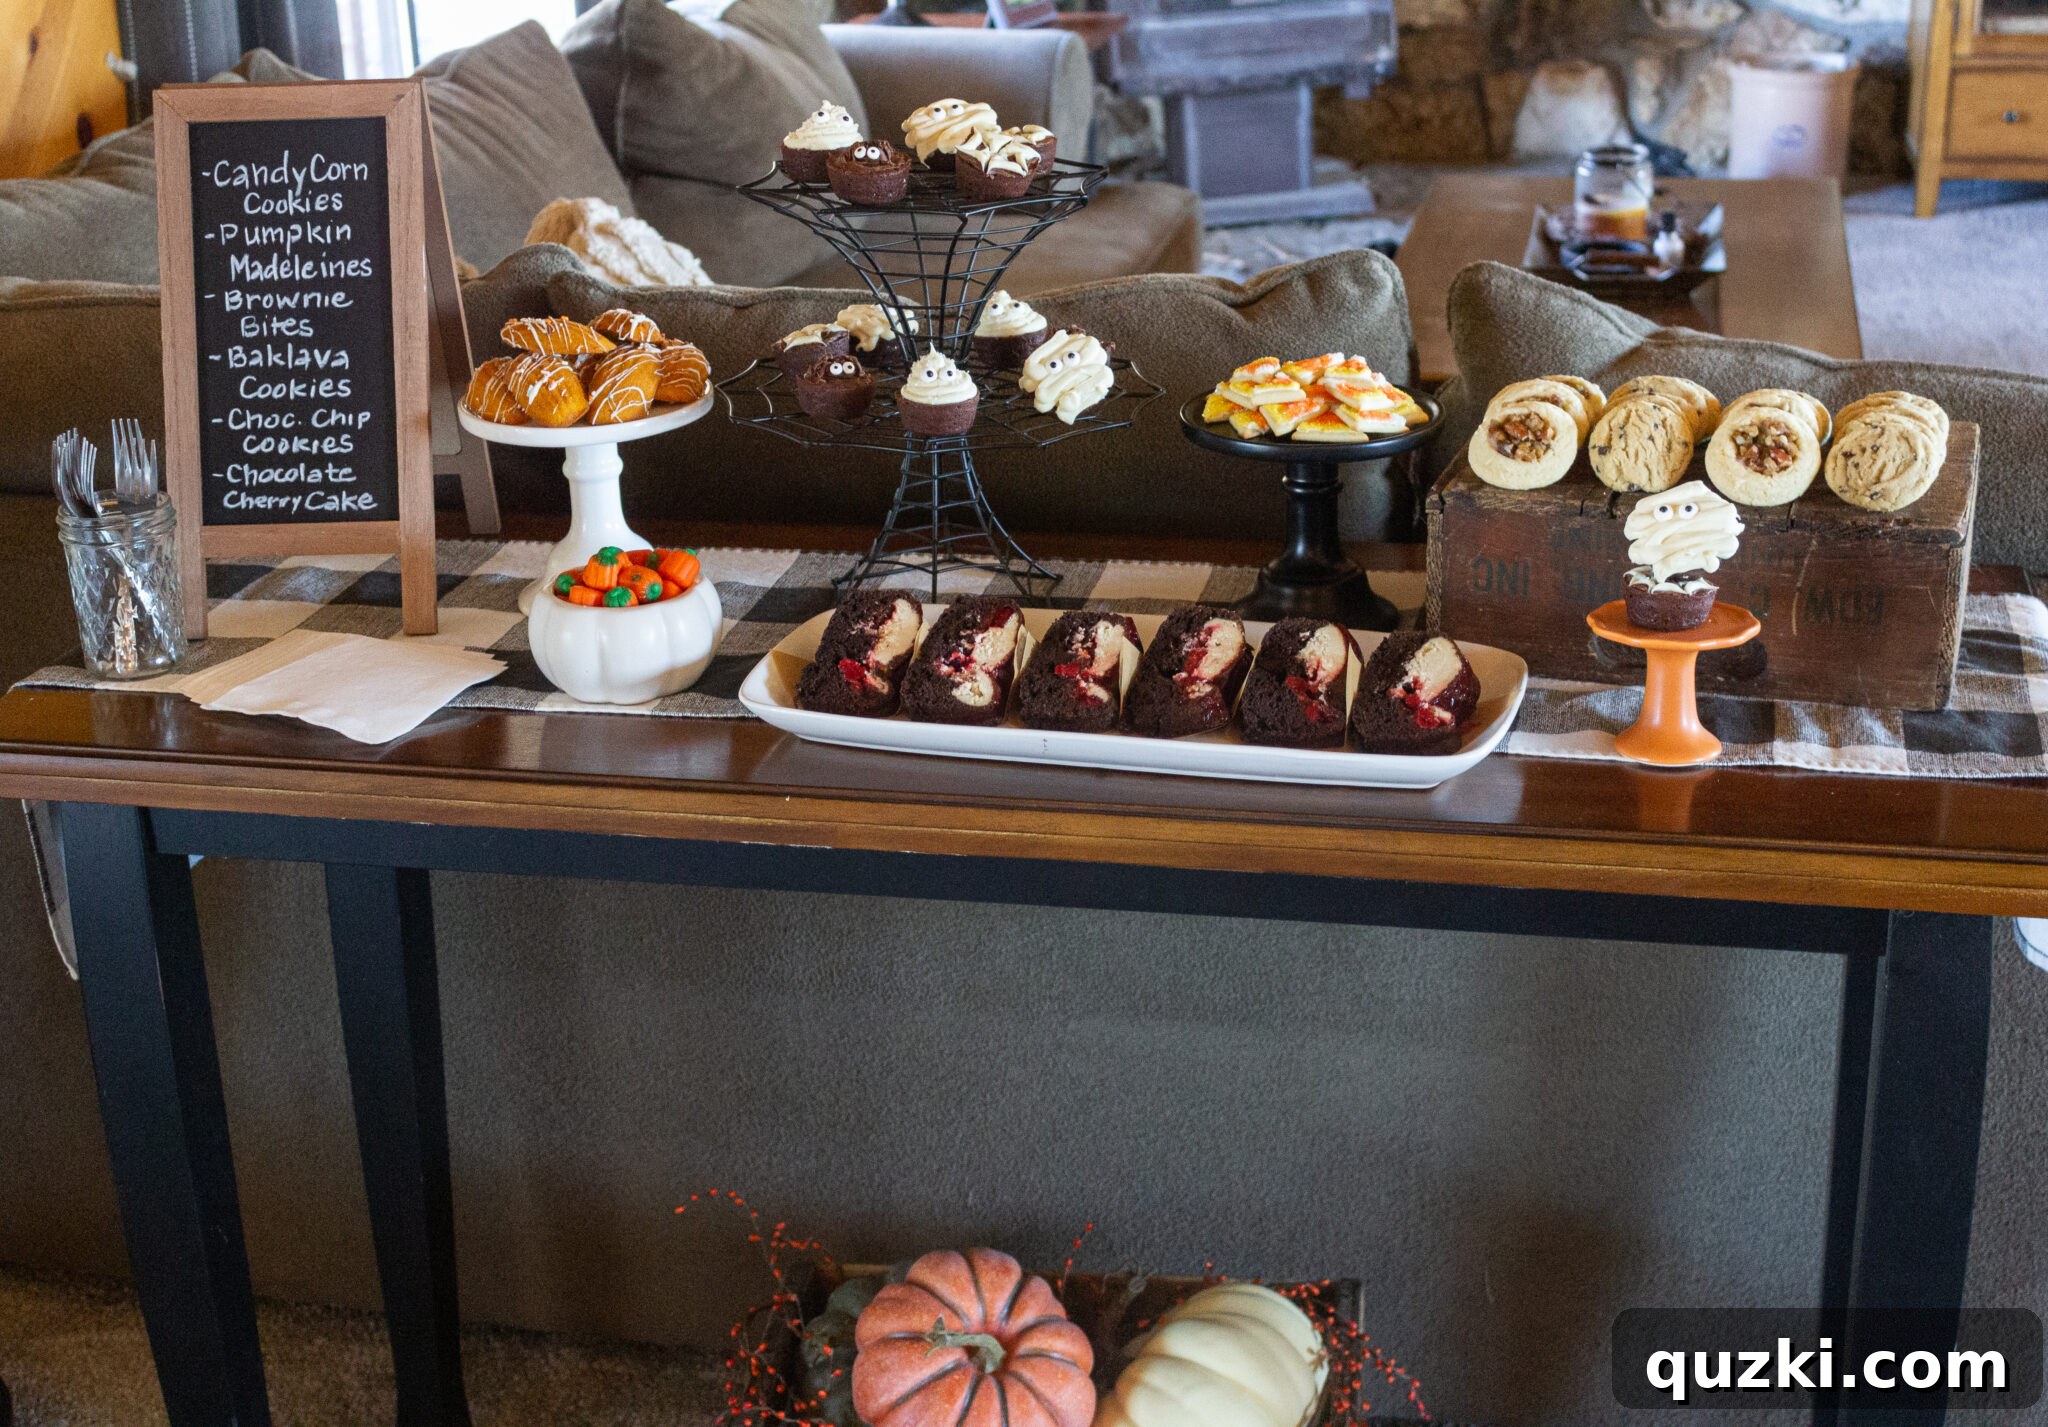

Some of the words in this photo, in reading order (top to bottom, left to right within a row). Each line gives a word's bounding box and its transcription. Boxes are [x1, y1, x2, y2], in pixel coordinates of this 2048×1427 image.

[243, 189, 343, 216] Cookies
[230, 252, 373, 282] Madeleines
[240, 315, 314, 338] Bites
[239, 376, 352, 400] Cookies
[311, 408, 371, 430] Chip
[242, 434, 354, 454] Cookies
